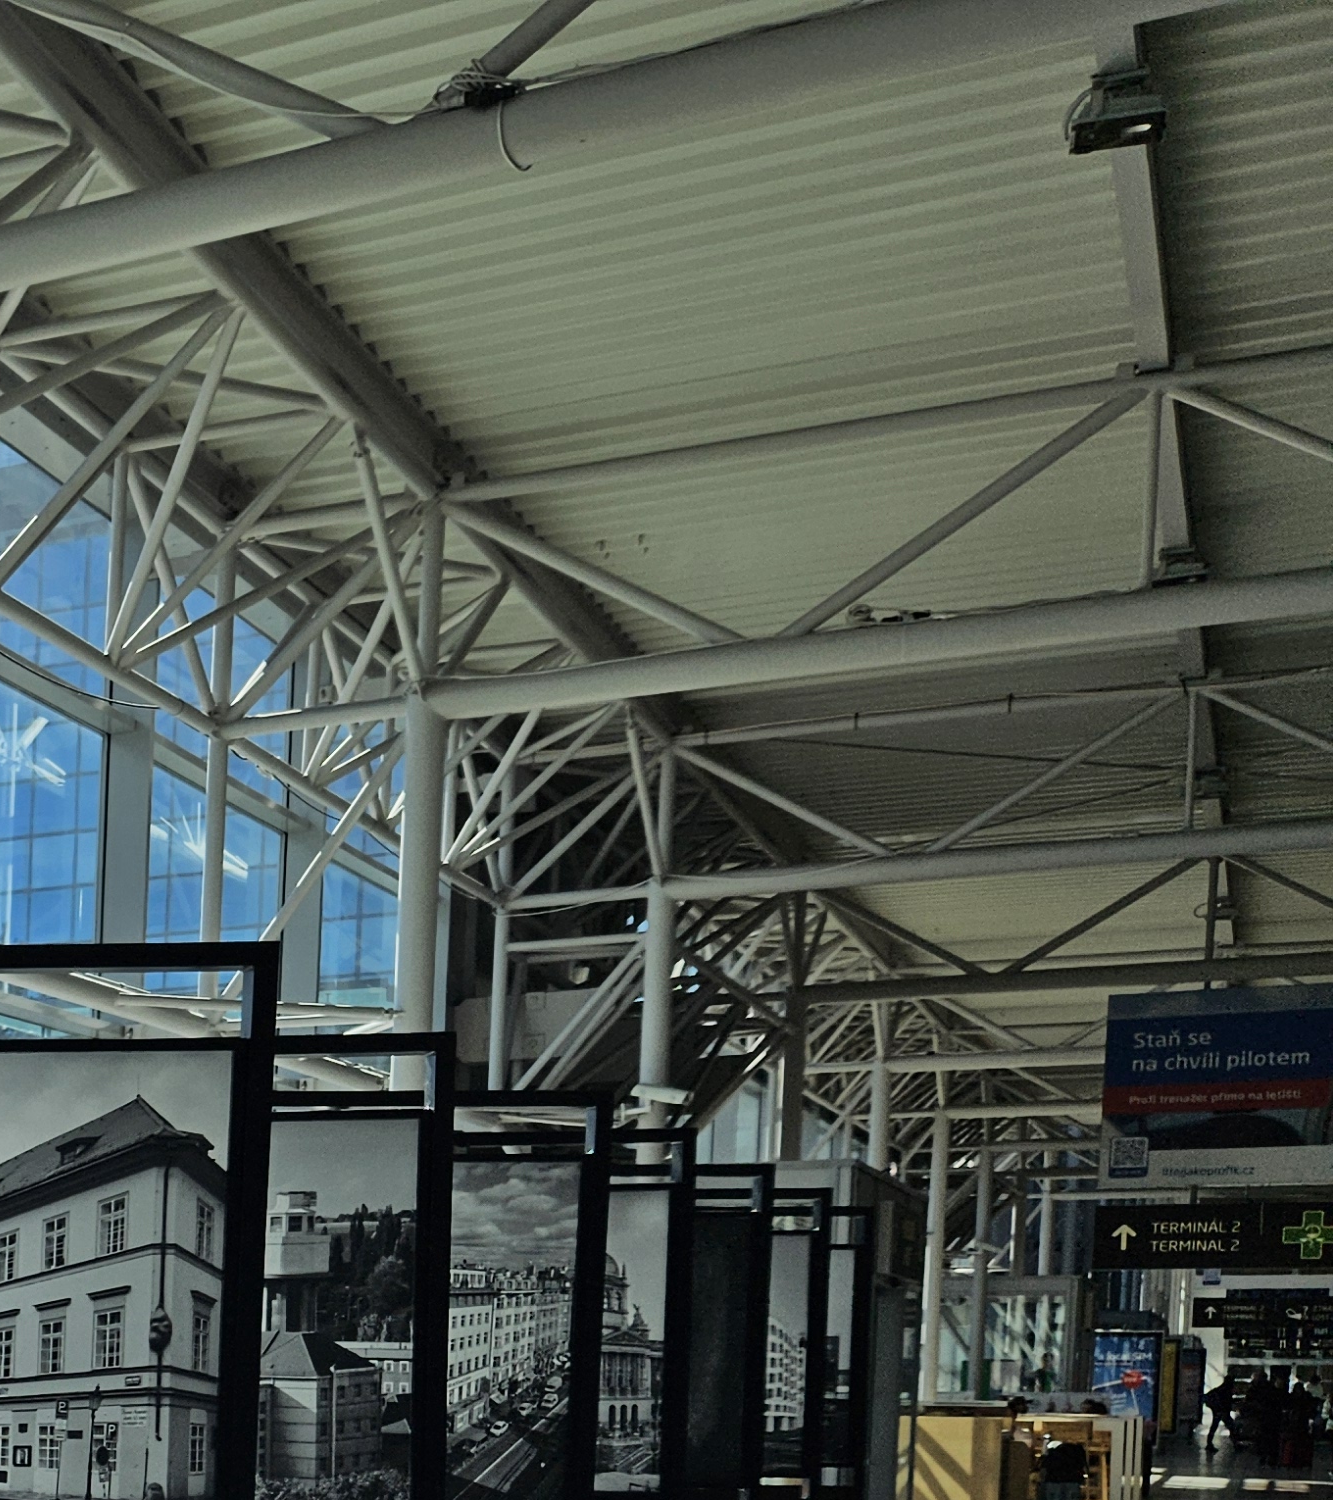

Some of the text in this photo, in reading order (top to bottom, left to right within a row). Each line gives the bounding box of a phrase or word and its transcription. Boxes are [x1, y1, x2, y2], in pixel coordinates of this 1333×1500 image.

[1133, 1030, 1213, 1049] Staň se
[1133, 1049, 1311, 1072] na chvíli pilotem
[1151, 1218, 1241, 1234] TERMINÁL 2
[1149, 1239, 1240, 1252] TERMINAL 2
